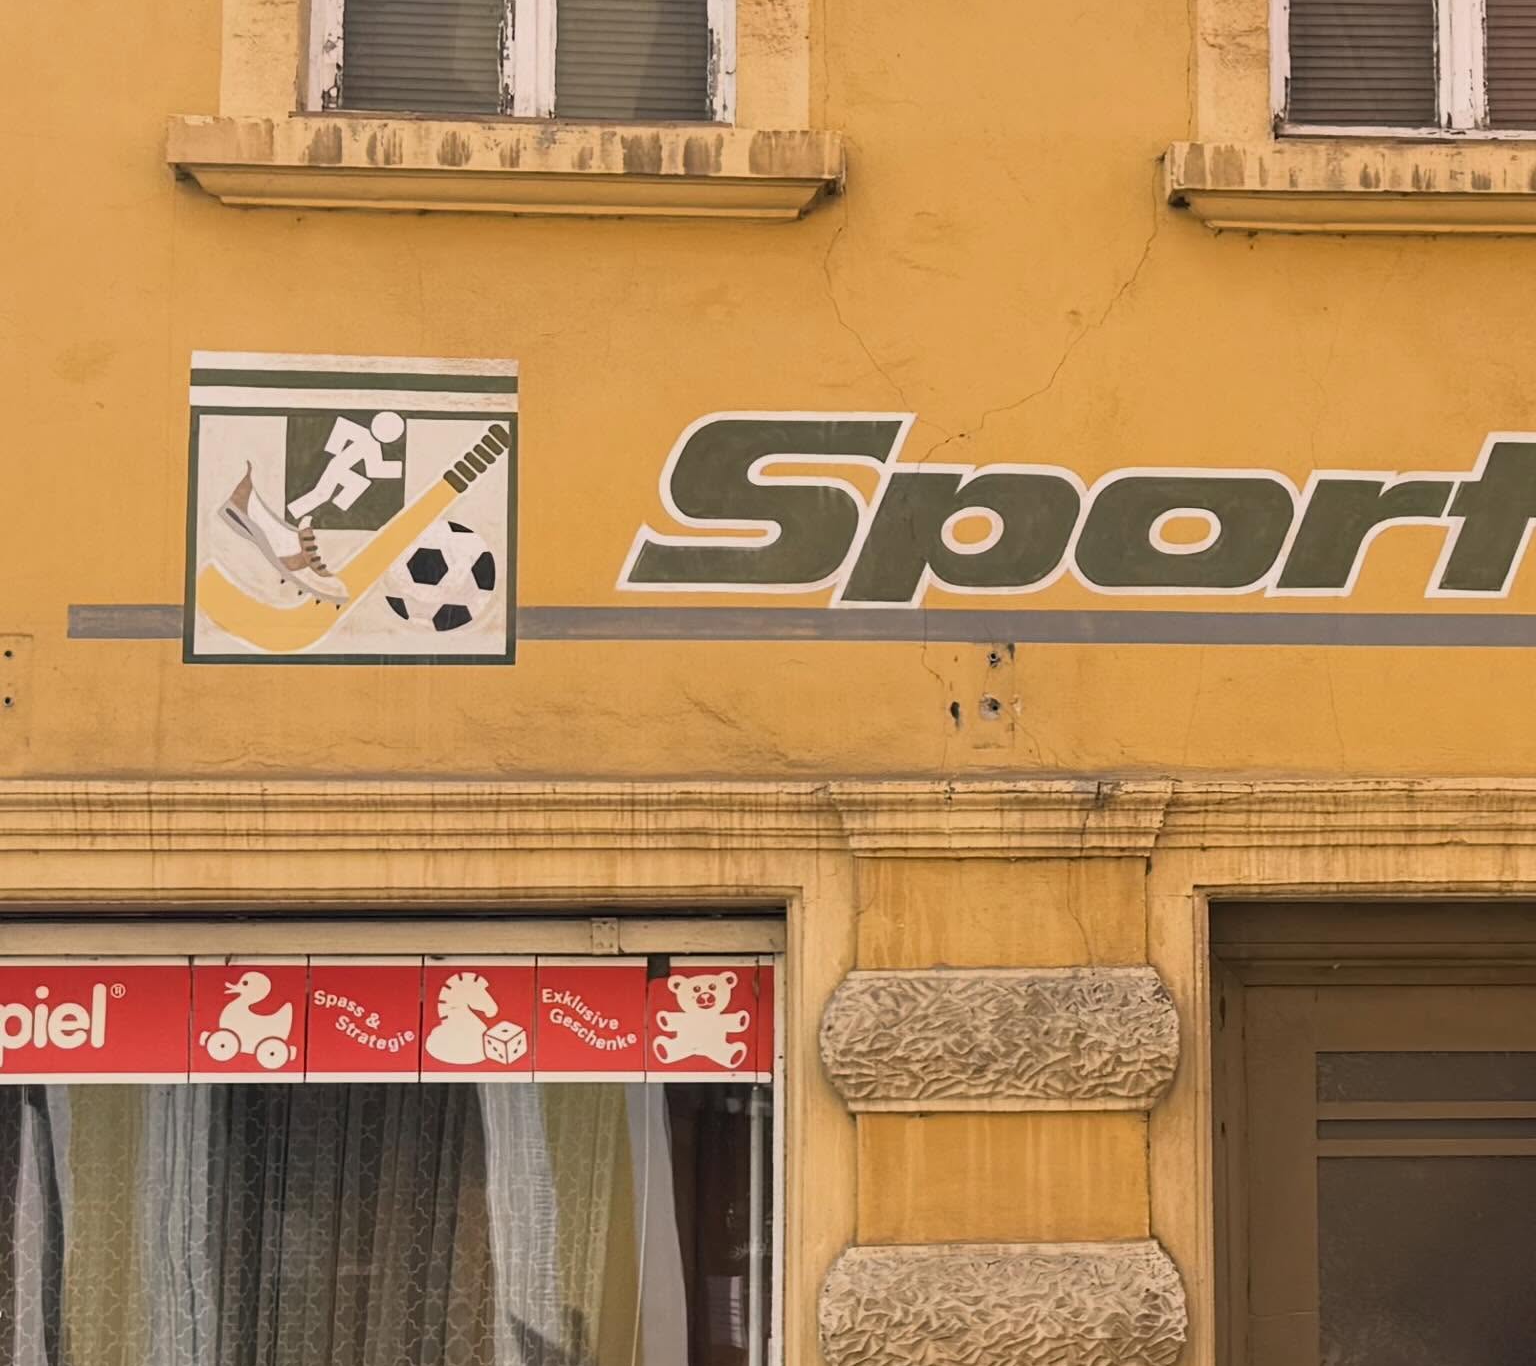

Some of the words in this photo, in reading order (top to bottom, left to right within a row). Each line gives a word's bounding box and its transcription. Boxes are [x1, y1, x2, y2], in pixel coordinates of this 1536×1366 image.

[313, 990, 365, 1018] Spass
[365, 1011, 382, 1029] &
[542, 988, 620, 1031] Exklusive
[549, 1008, 637, 1051] Geschenke
[335, 1015, 415, 1052] Strategie
